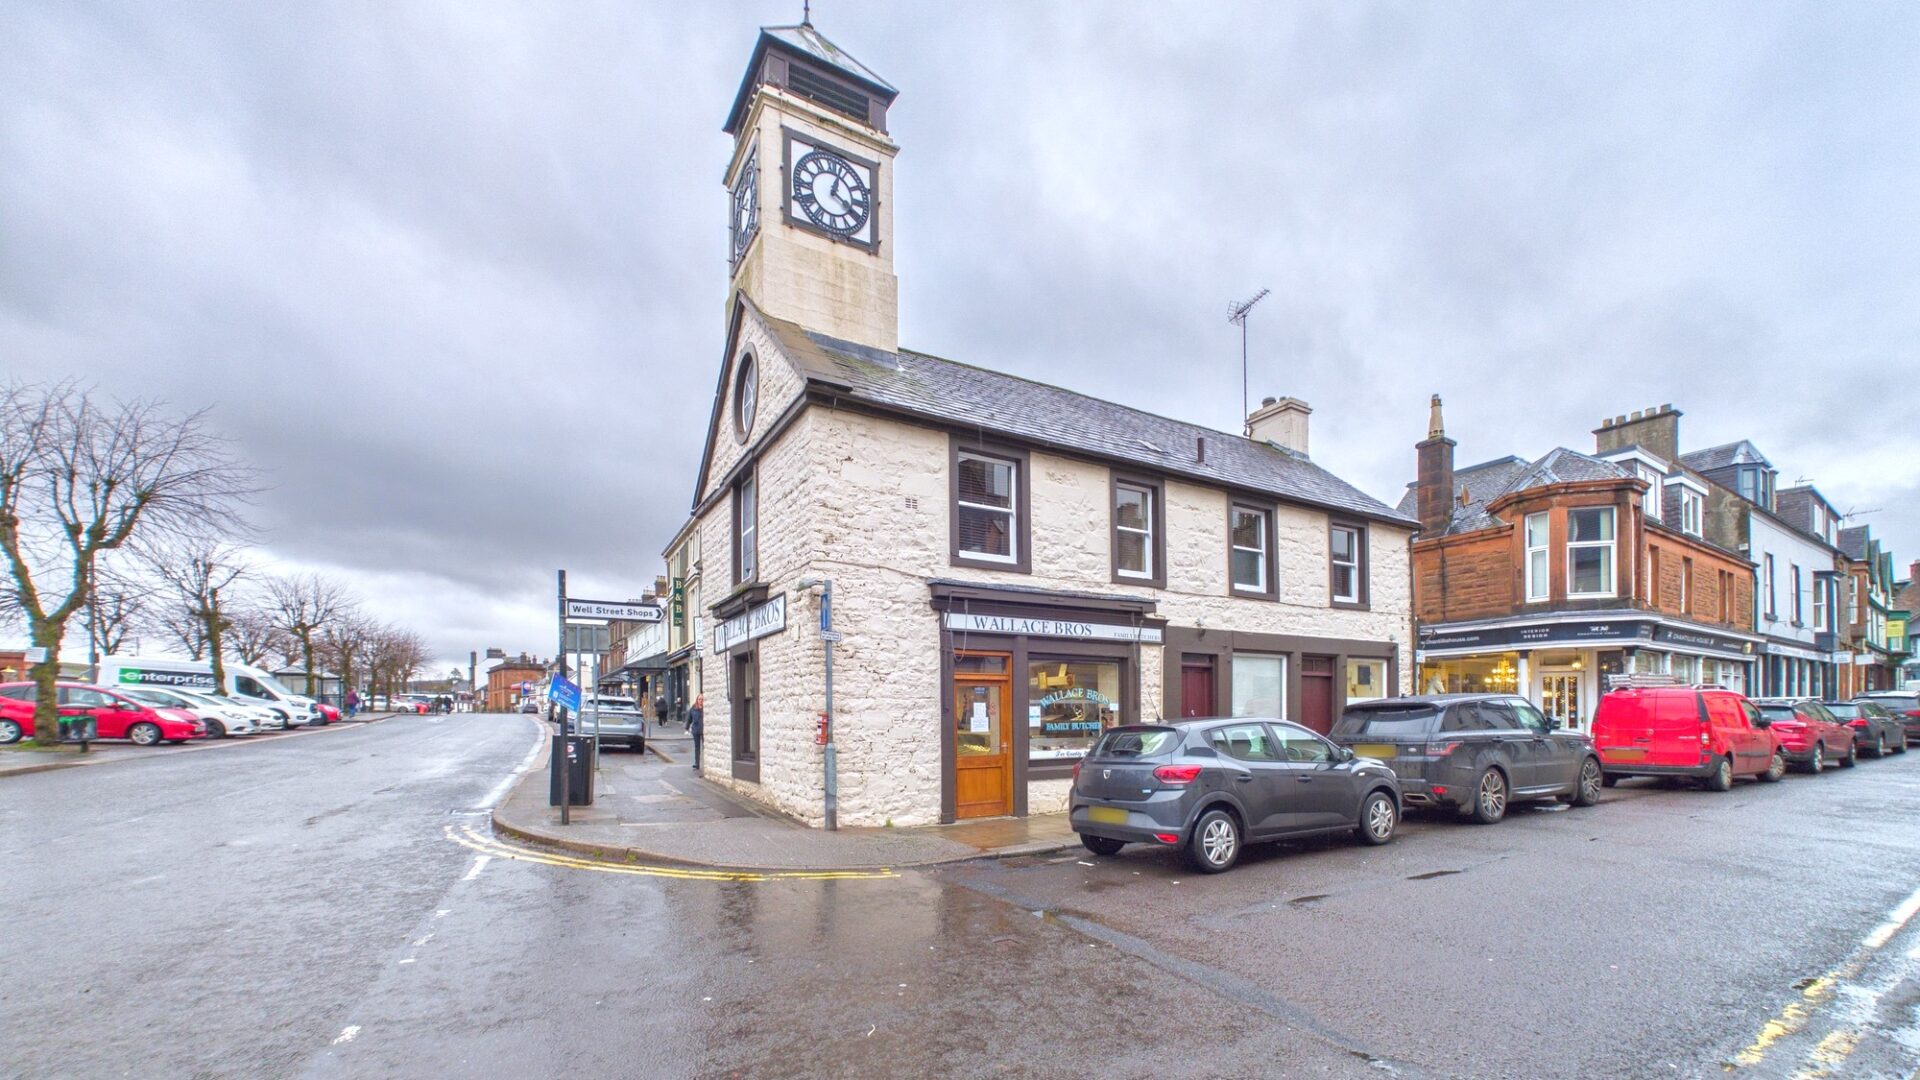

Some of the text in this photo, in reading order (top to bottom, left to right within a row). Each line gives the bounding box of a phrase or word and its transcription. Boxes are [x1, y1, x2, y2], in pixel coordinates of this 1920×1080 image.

[572, 605, 653, 618] Well Street Shops
[755, 600, 780, 629] BROS
[974, 616, 1092, 636] WALLACE BROS
[123, 672, 215, 685] enterprise
[1040, 688, 1111, 709] WALLACE BROS
[1045, 722, 1070, 731] FAMILY
